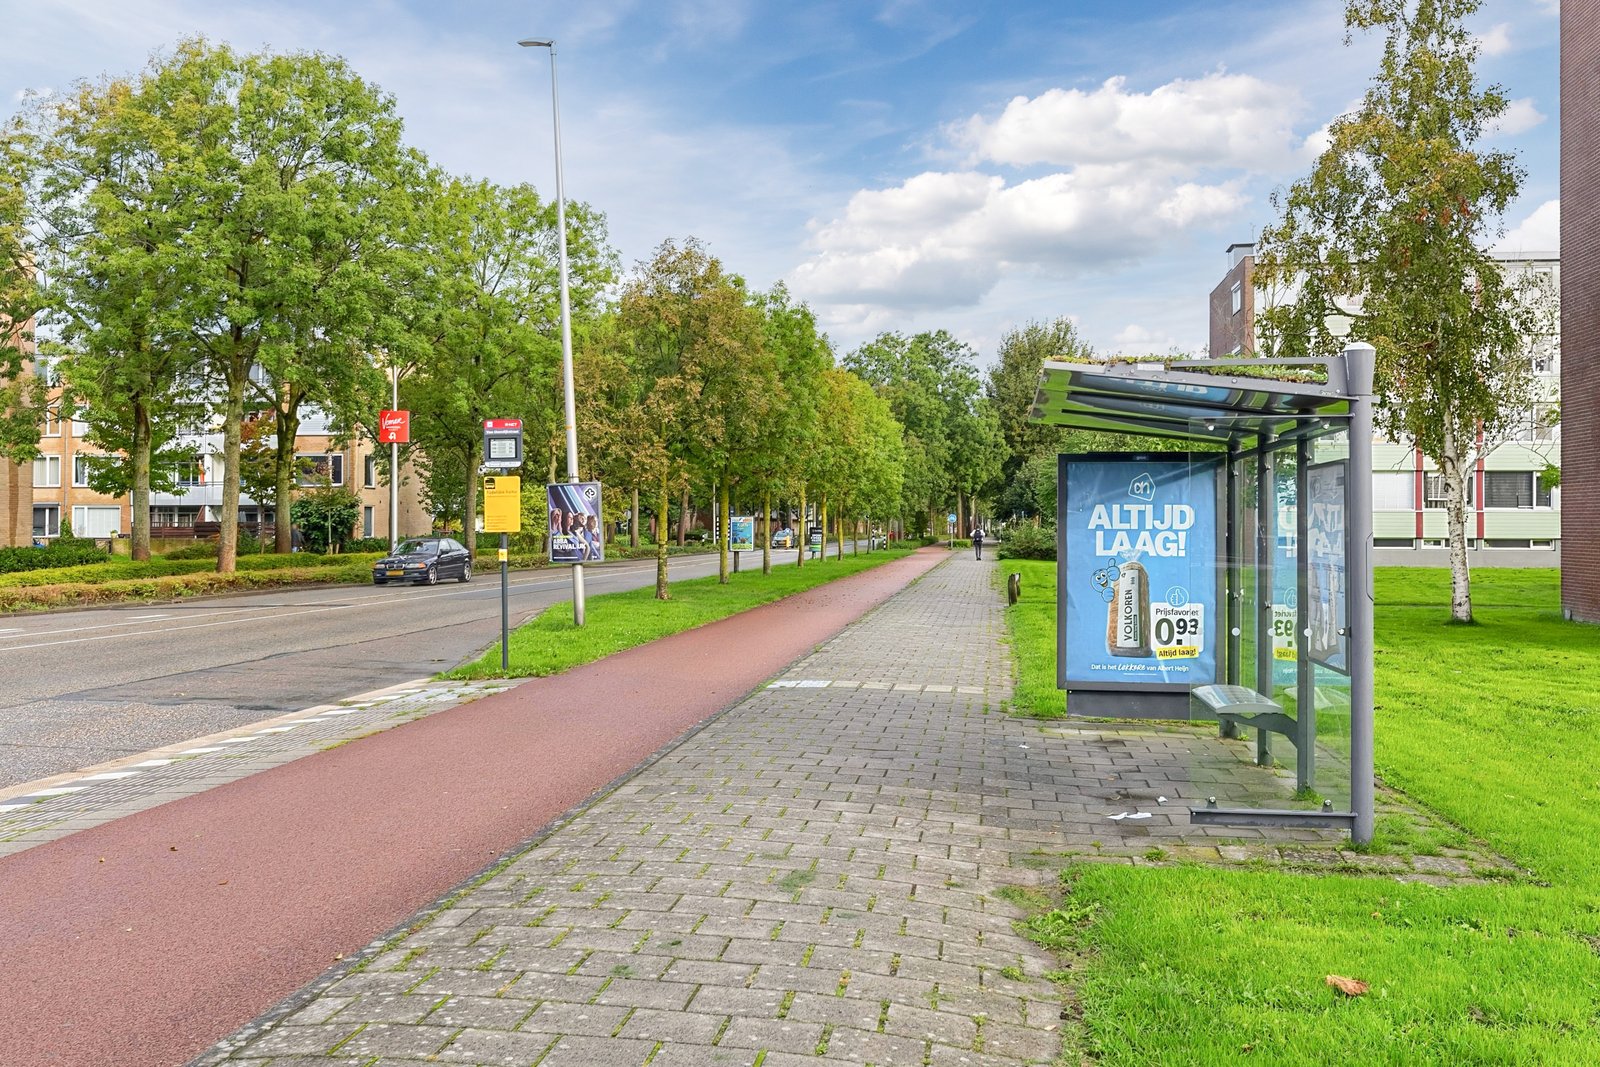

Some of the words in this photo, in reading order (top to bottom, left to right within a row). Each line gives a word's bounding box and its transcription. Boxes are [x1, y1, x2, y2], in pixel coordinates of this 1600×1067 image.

[1087, 503, 1195, 530] ALTIJD
[1095, 530, 1187, 557] LAAG!
[1124, 589, 1133, 641] VOLKOREN
[1155, 608, 1199, 617] Prijsfavoriet
[1158, 648, 1177, 657] Altijd
[1178, 648, 1196, 657] laag!
[1174, 665, 1189, 673] Heijn
